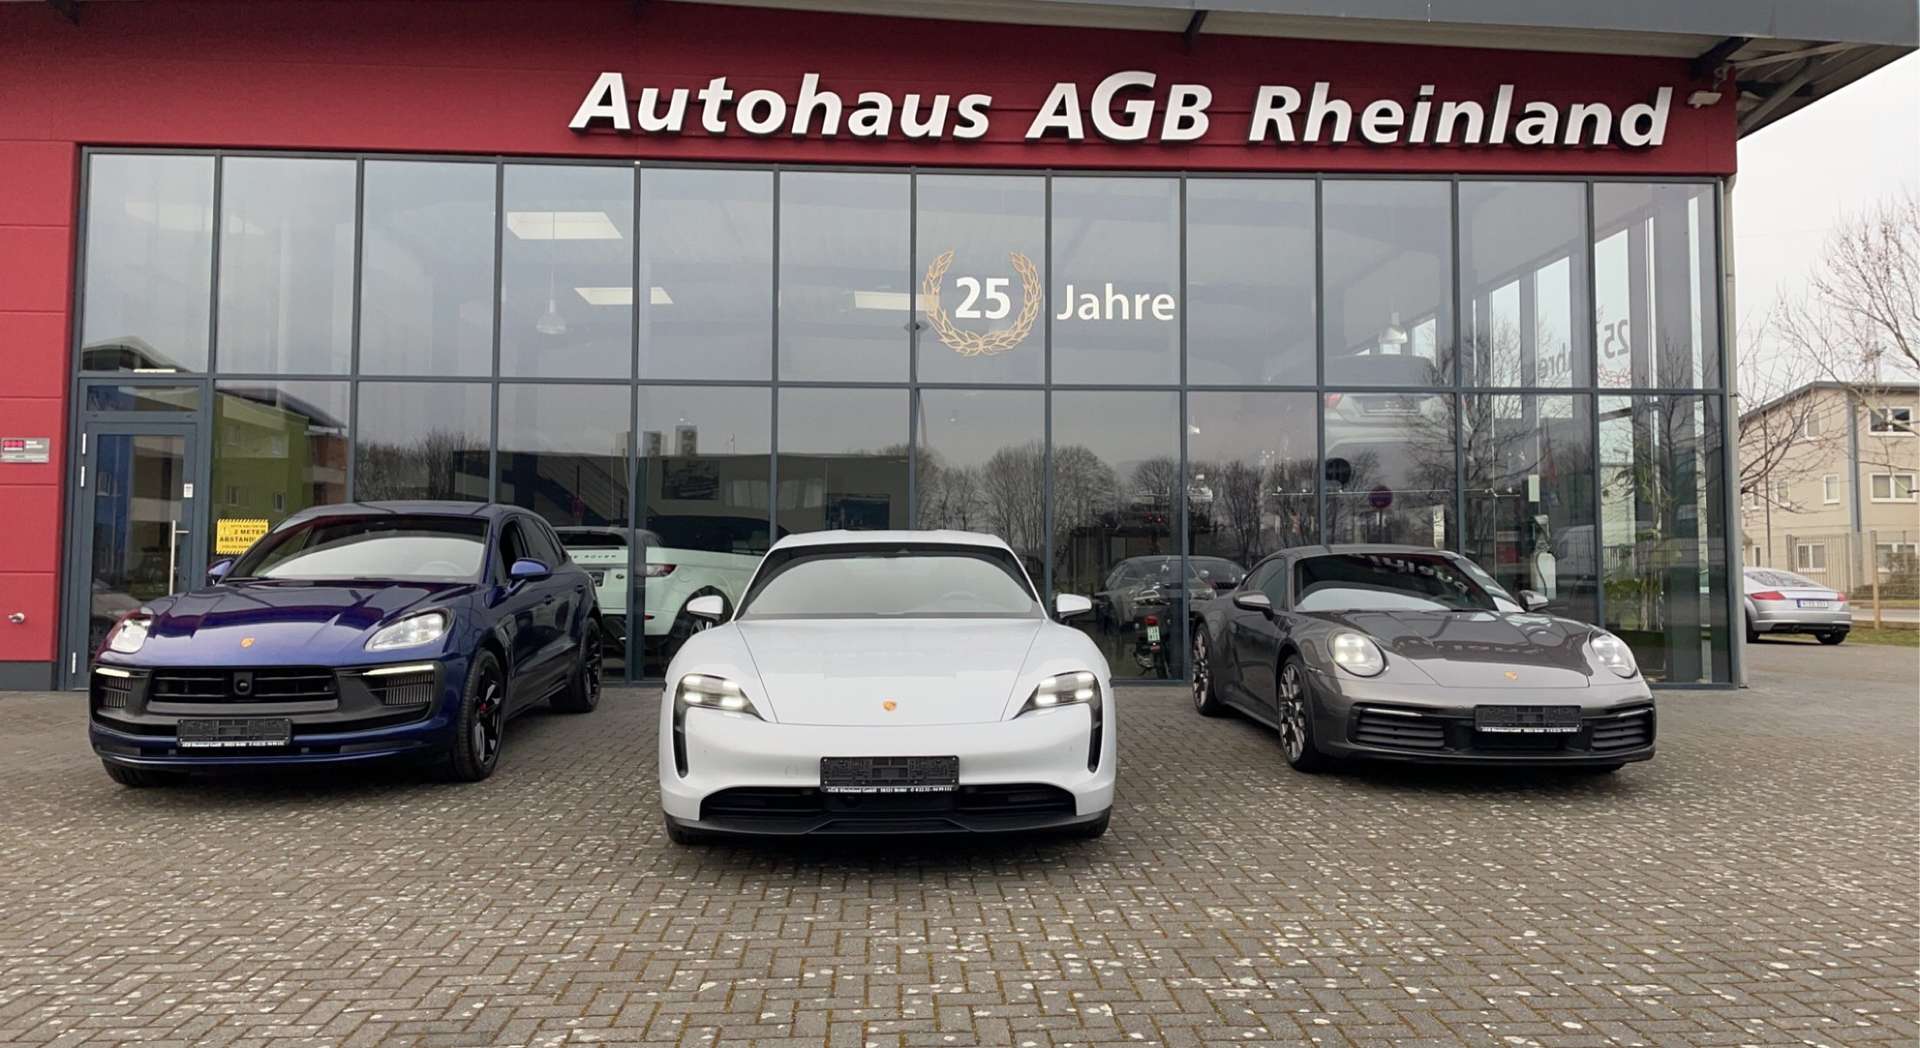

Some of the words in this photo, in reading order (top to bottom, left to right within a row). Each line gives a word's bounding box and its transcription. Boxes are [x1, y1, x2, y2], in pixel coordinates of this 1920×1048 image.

[568, 72, 992, 138] Autohaus
[1024, 70, 1212, 141] AGB
[1248, 82, 1673, 147] Rheinland
[955, 276, 1011, 320] 25
[1056, 283, 1176, 321] Jahre
